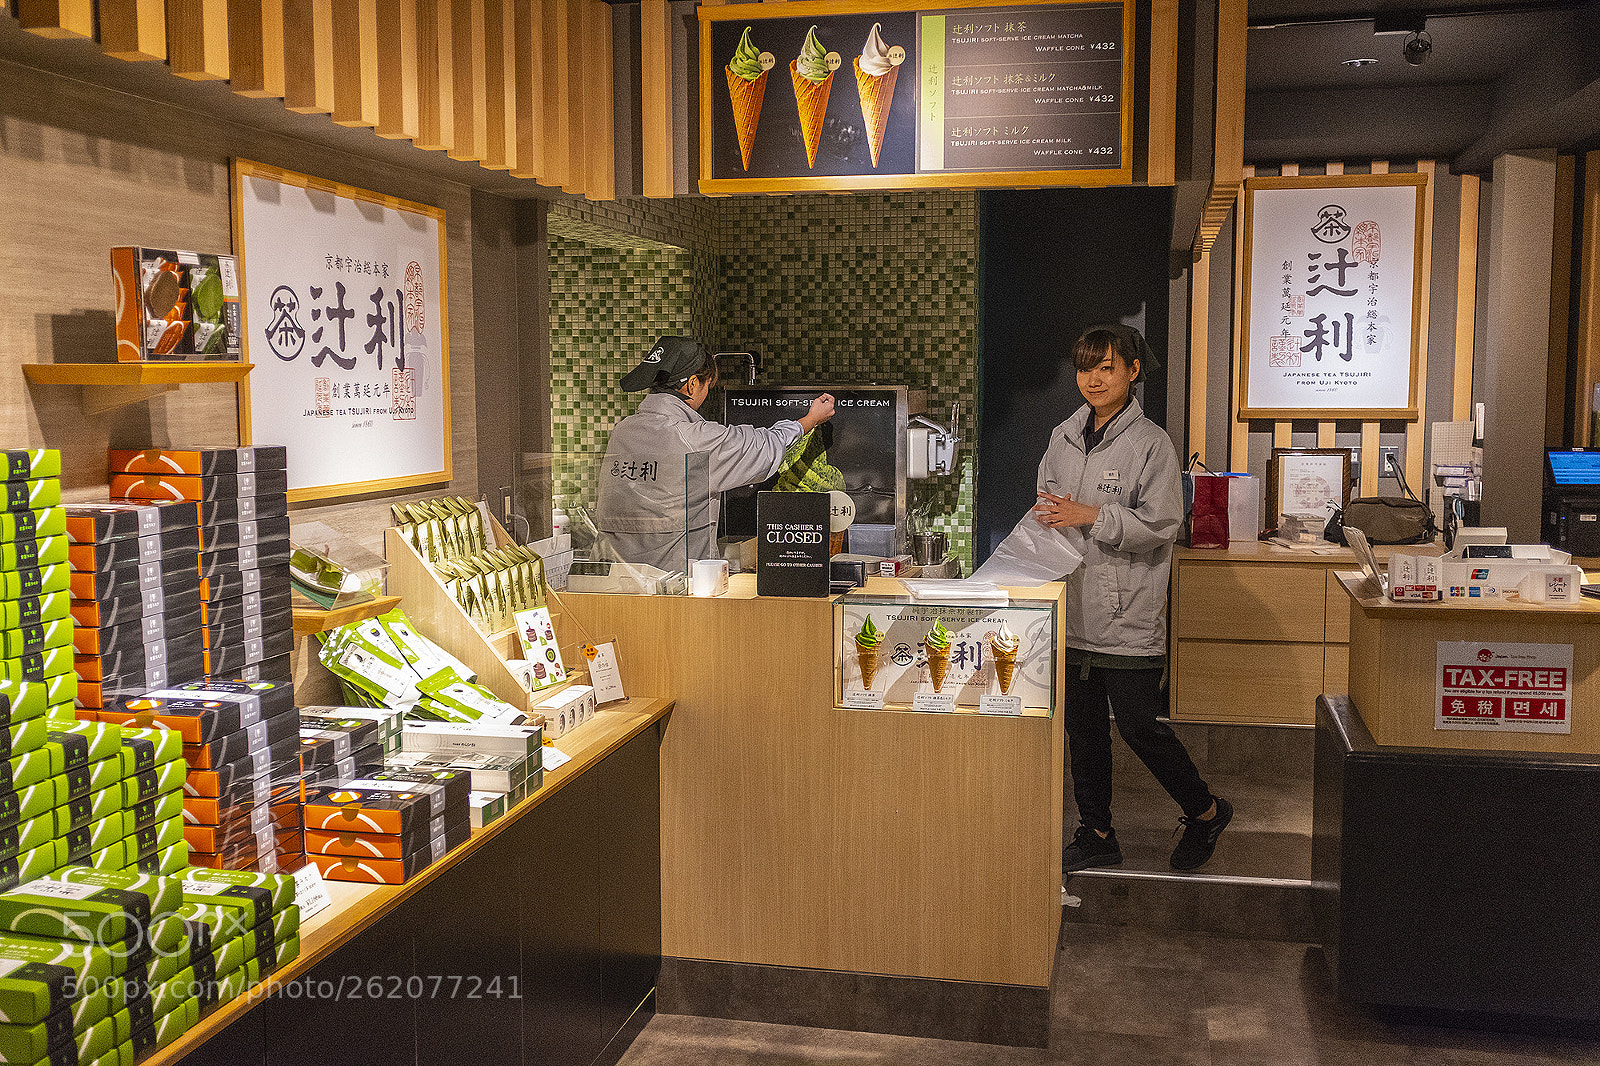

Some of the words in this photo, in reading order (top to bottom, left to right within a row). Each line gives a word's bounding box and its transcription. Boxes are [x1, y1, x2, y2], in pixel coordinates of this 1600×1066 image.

[981, 35, 1019, 43] SOFT-SERVE
[1090, 42, 1115, 50] ¥432
[1089, 95, 1114, 103] ¥432
[1088, 147, 1114, 155] ¥432
[1300, 248, 1358, 362] 辻利
[310, 281, 405, 372] 辻利
[731, 398, 772, 406] TSUJIRI
[838, 399, 854, 407] ICE
[857, 399, 890, 407] CREAM
[348, 407, 372, 415] TSUJIRI
[621, 460, 658, 482] 辻利
[1102, 483, 1123, 495] 辻利
[766, 531, 823, 544] CLOSED
[886, 614, 918, 622] TSUJIRI
[1446, 669, 1563, 688] TAX-FREE
